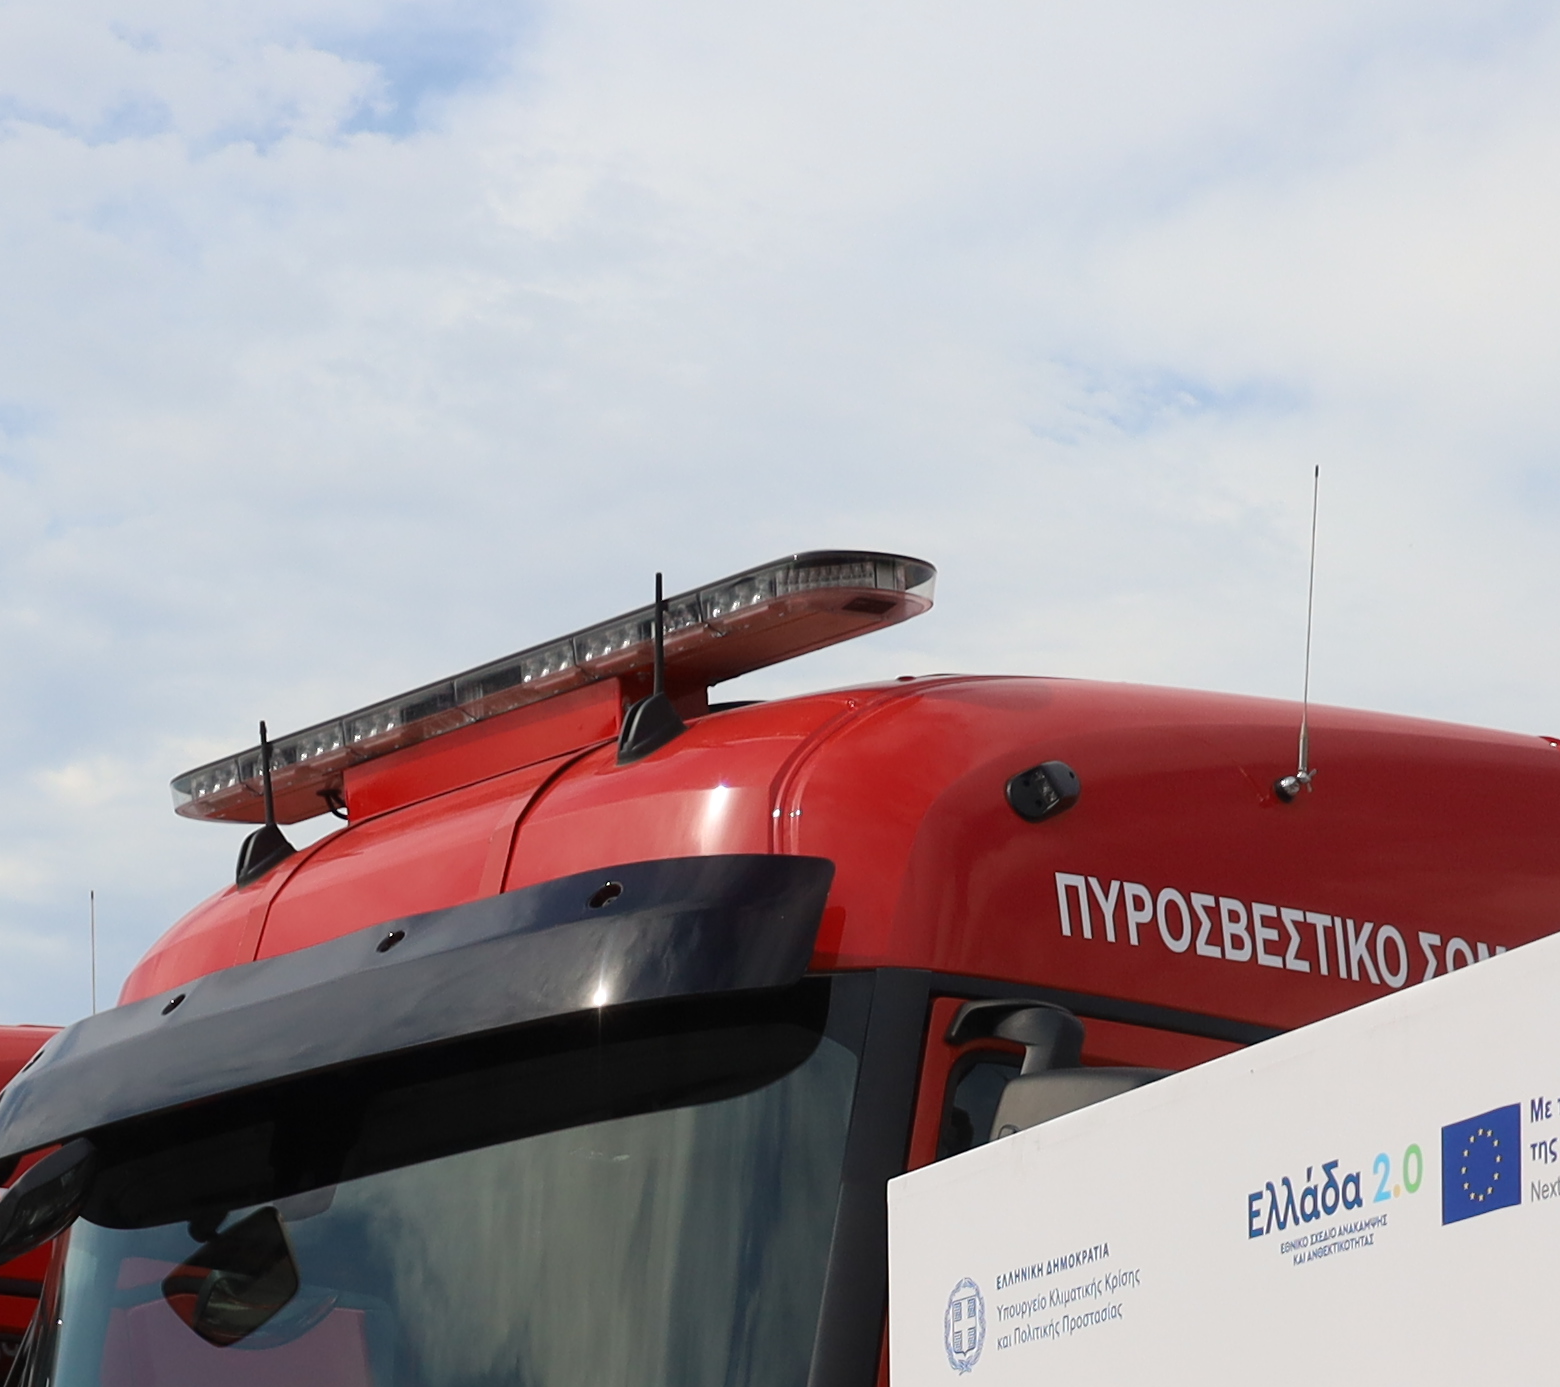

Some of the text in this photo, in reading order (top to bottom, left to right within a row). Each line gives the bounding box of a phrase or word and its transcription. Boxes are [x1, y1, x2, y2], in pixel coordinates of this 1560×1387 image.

[1055, 872, 1408, 989] ΠΥΡΟΣΒΕΣΤΙΚΟ
[1530, 1097, 1552, 1123] Με
[1530, 1137, 1557, 1164] της
[1248, 1143, 1423, 1239] Ελλάδα 2.0
[996, 1243, 1110, 1290] ΕΛΛΗΝΙΚΗ ΔΗΜΟΚΡΑΤΙΑ
[997, 1268, 1140, 1322] Υπουργείο Κλιματικής Κρίσης
[997, 1302, 1123, 1351] και Πολιτικής Προστασίας
